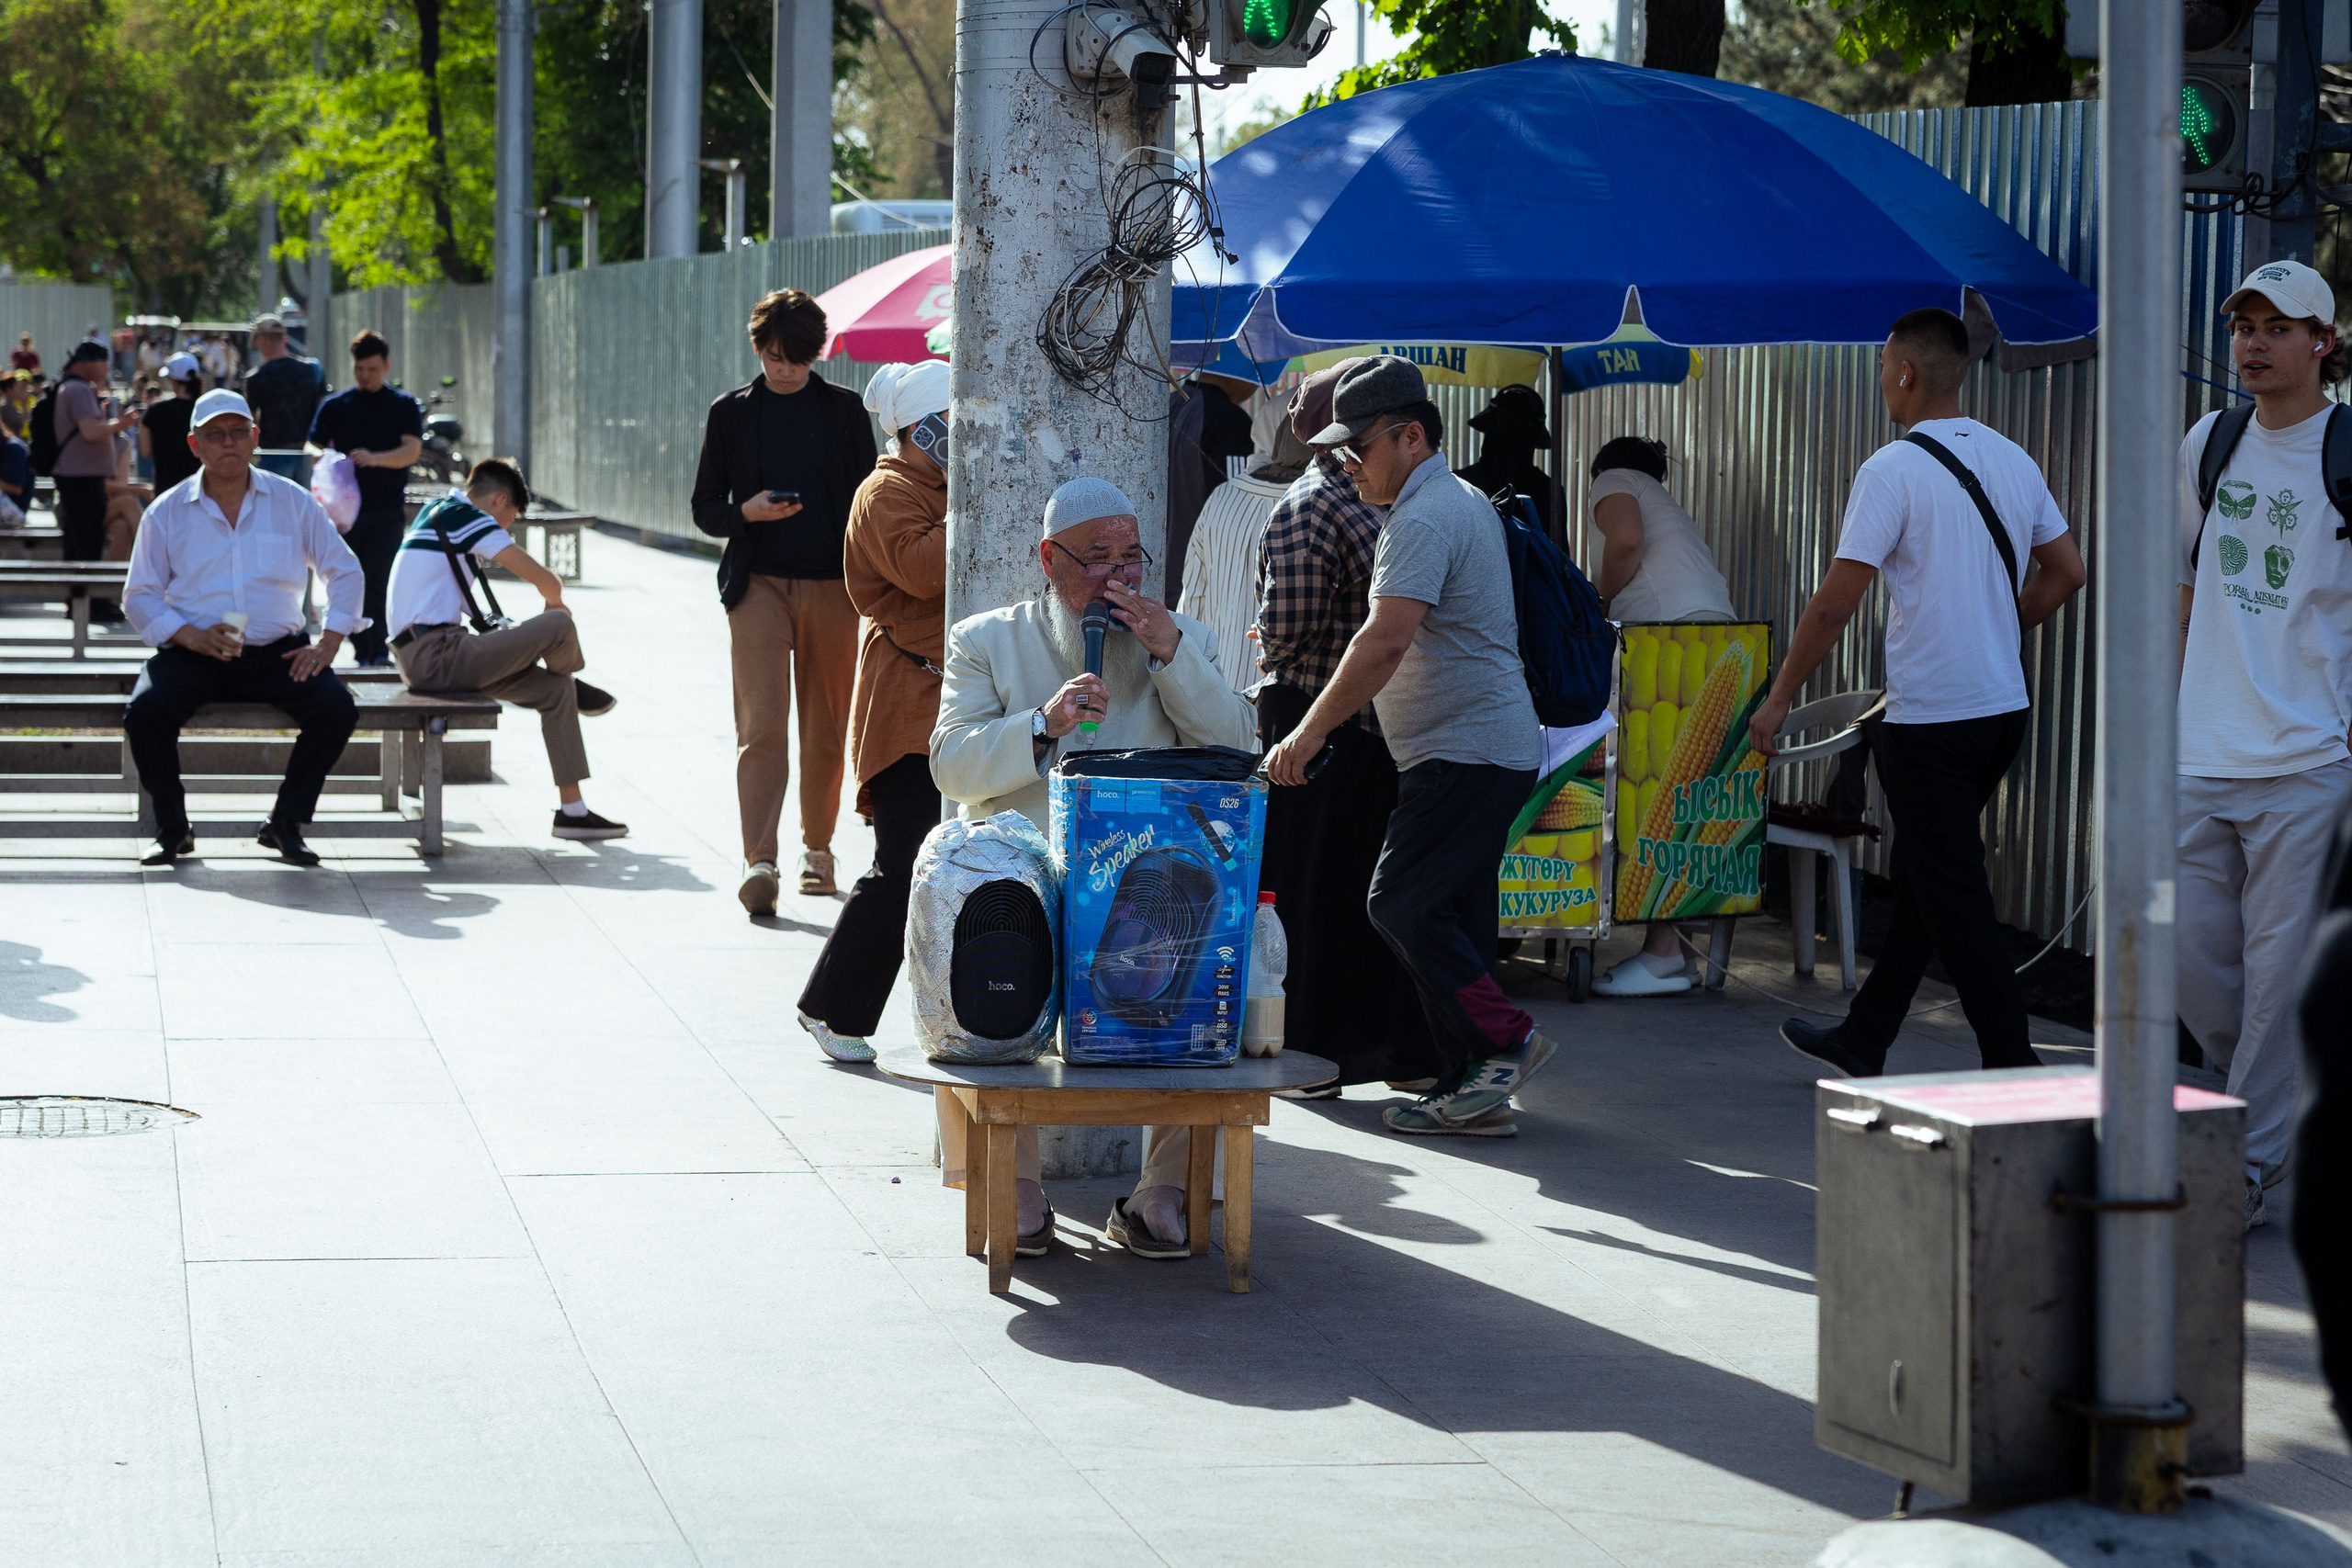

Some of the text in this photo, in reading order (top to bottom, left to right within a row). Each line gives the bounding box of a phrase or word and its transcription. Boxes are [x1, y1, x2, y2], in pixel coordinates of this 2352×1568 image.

[1219, 797, 1240, 809] DS26
[1672, 768, 1762, 825] ЫСЫК
[1089, 824, 1156, 892] Speaker
[1637, 837, 1761, 897] ГОРЯЧАЯ
[1499, 886, 1598, 919] КУКУРУЗА
[988, 980, 1016, 991] hoco.
